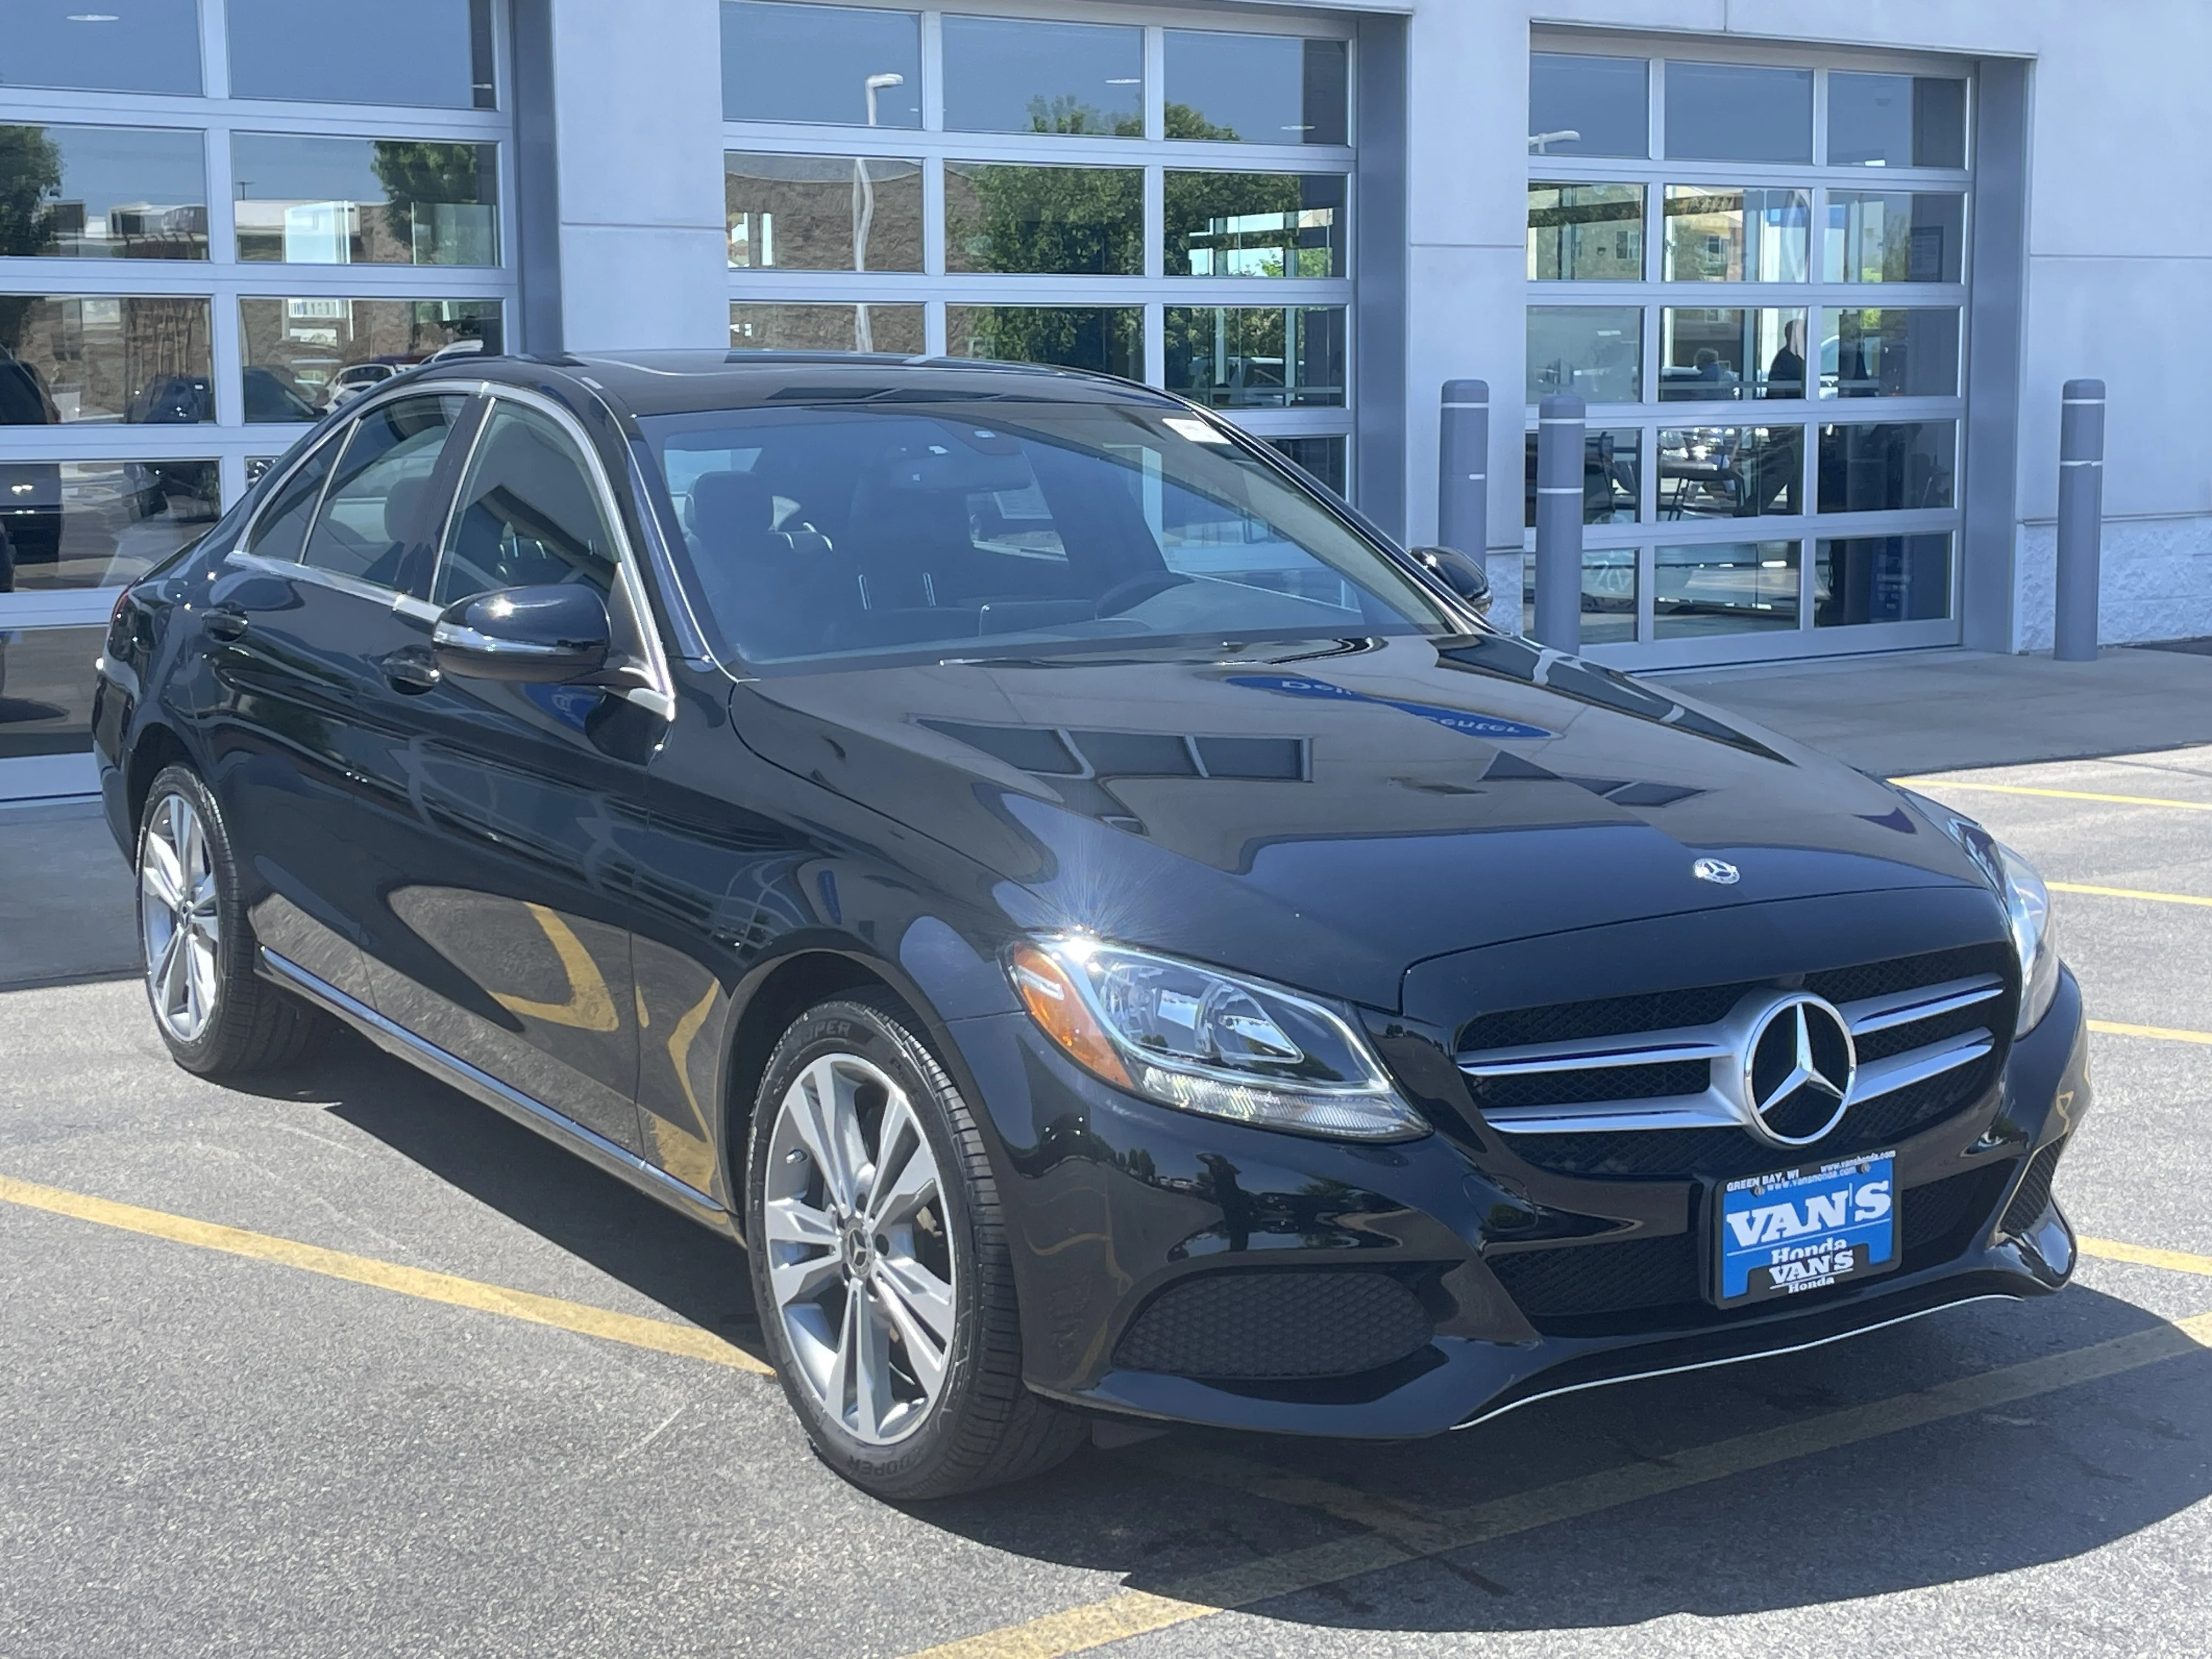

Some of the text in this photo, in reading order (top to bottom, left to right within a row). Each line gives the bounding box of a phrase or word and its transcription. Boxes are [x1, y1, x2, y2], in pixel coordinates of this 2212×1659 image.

[1726, 1176, 1760, 1192] GREEN
[1787, 1169, 1799, 1180] WI
[1771, 1237, 1847, 1265] Honda
[1788, 1276, 1835, 1294] Honda
